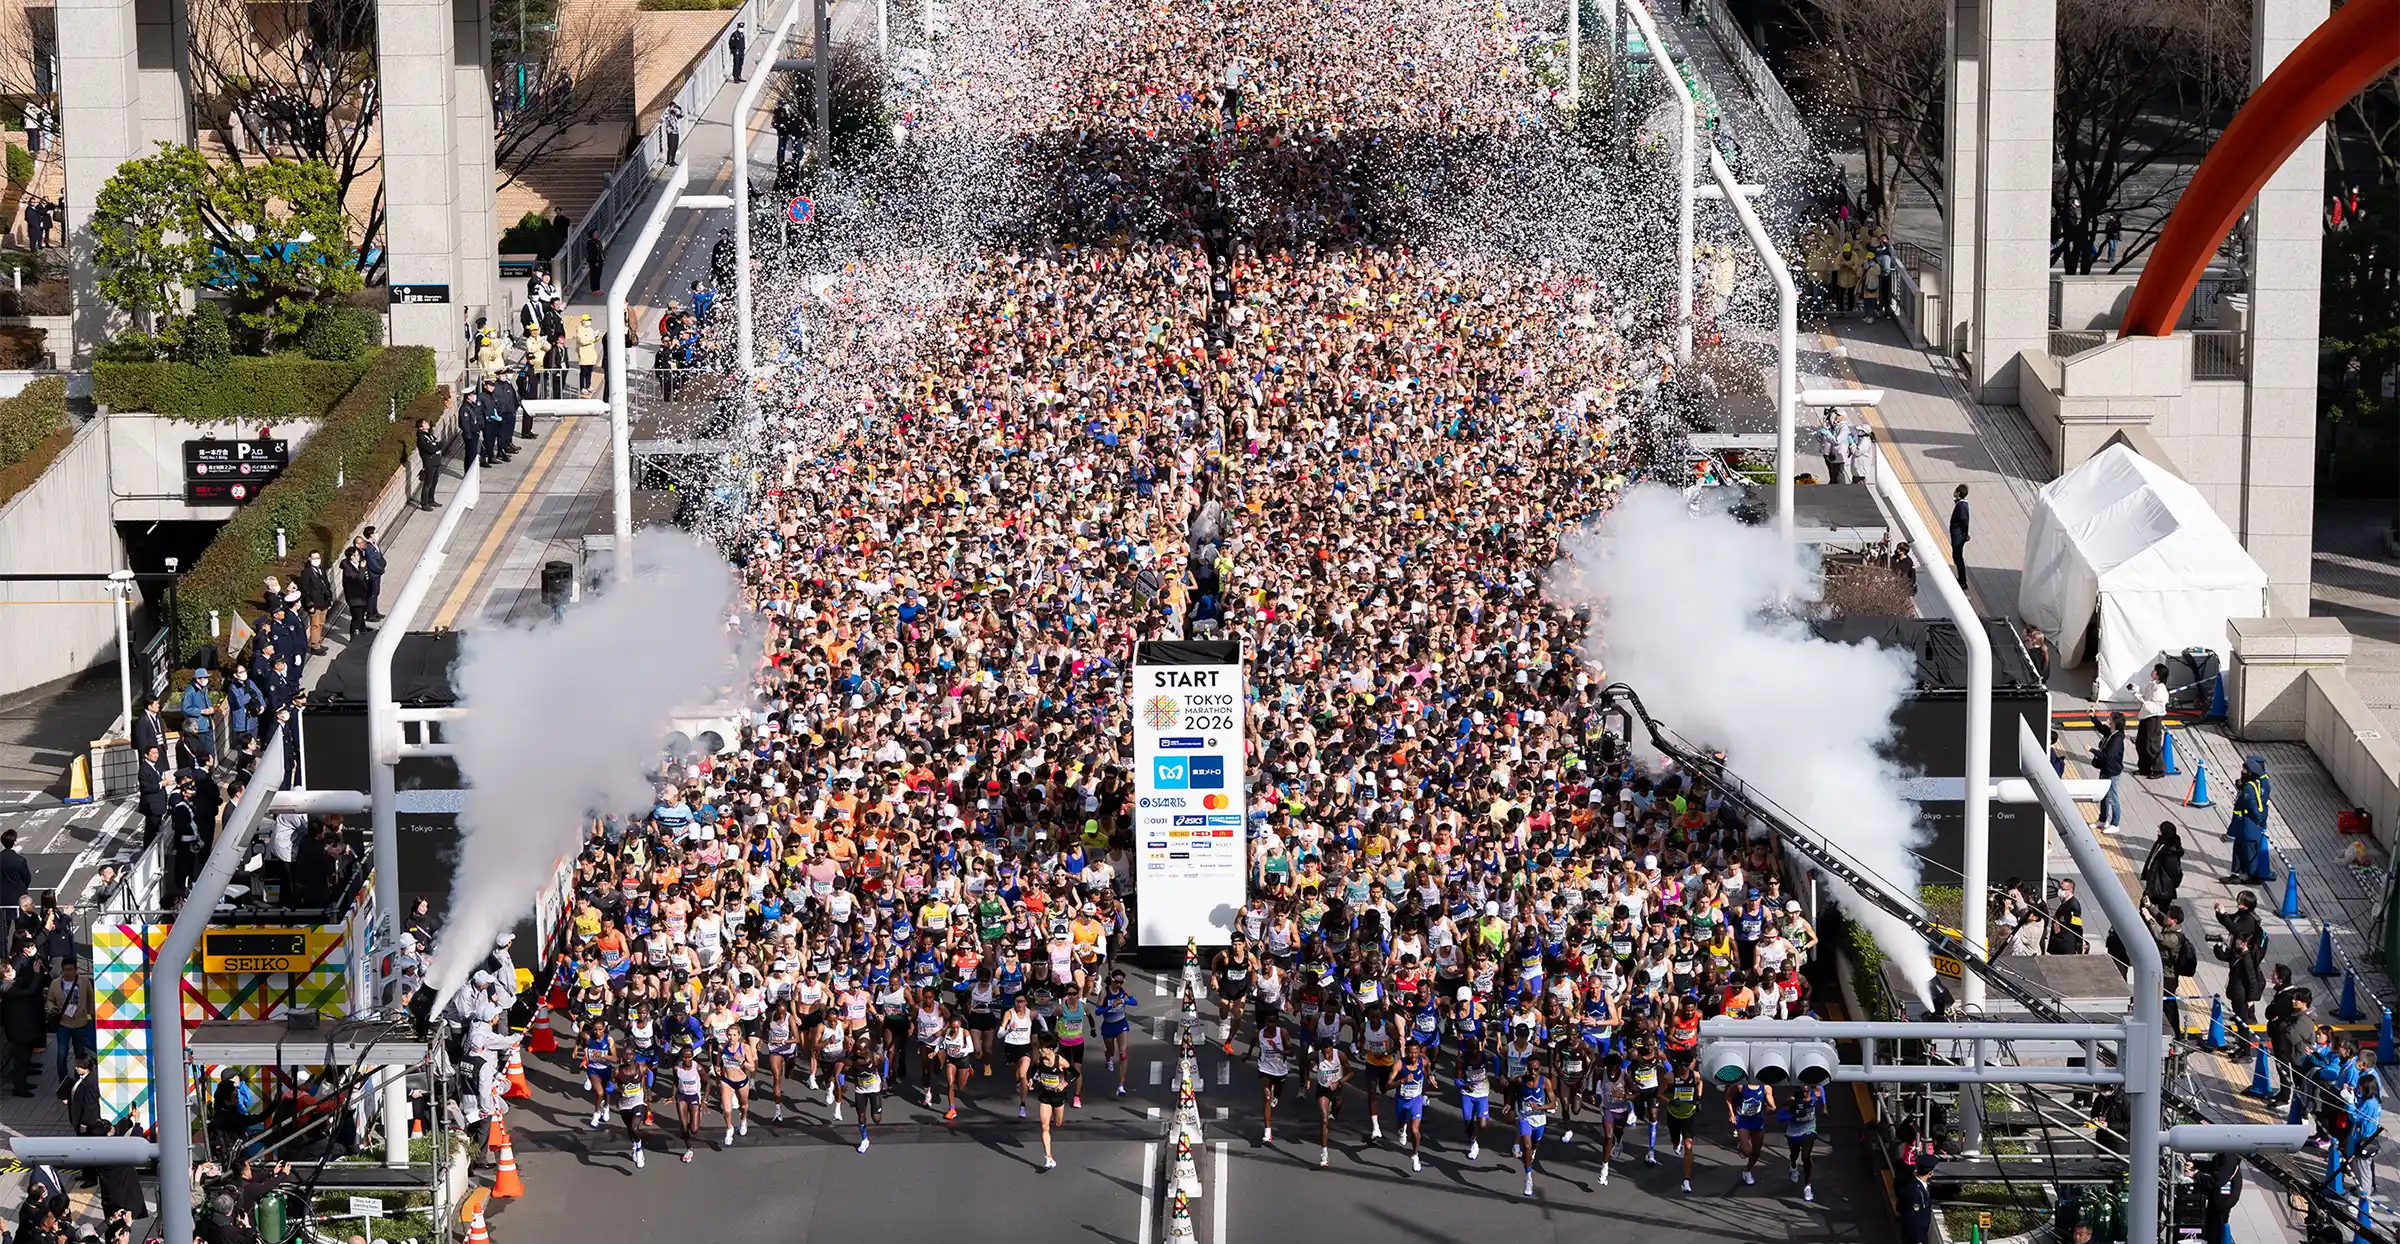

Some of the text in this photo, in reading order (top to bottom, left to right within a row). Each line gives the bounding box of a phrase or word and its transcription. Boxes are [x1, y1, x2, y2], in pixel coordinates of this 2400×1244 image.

[238, 443, 251, 459] P
[1154, 670, 1219, 687] START
[1184, 694, 1233, 705] TOKYO
[1185, 716, 1233, 730] 2026
[410, 825, 433, 833] Tokyo
[224, 957, 289, 971] SEIKO
[1934, 957, 1961, 975] IKO
